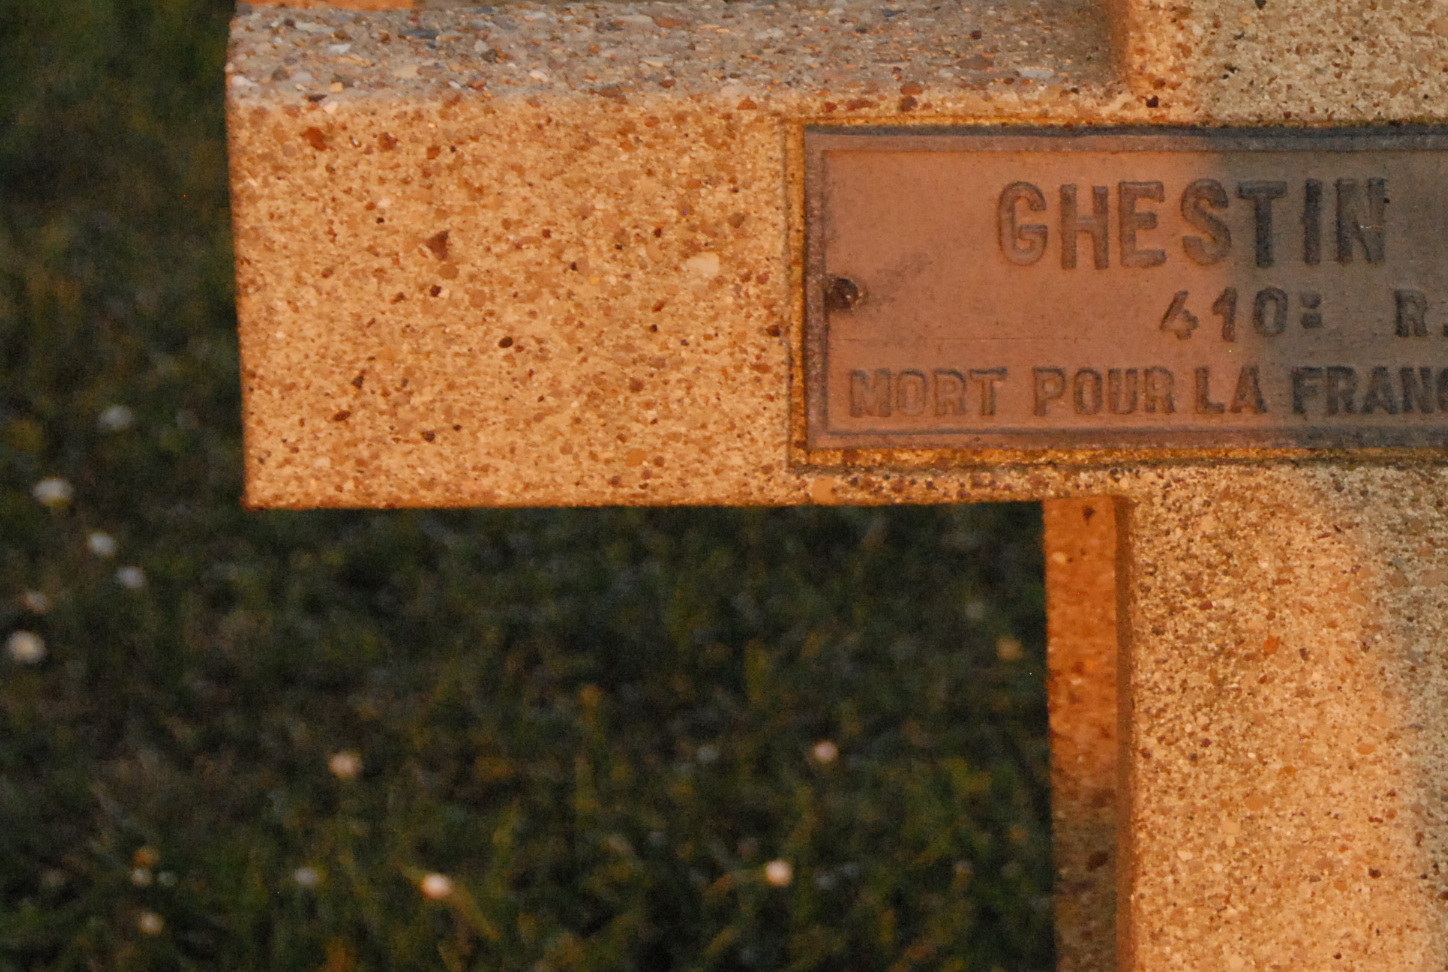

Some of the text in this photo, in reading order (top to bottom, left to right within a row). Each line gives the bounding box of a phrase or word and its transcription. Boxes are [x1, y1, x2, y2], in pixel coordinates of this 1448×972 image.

[997, 177, 1389, 272] GHESTIN
[849, 366, 1009, 419] MORT
[1032, 365, 1175, 417] POUR
[1194, 364, 1268, 416] LA
